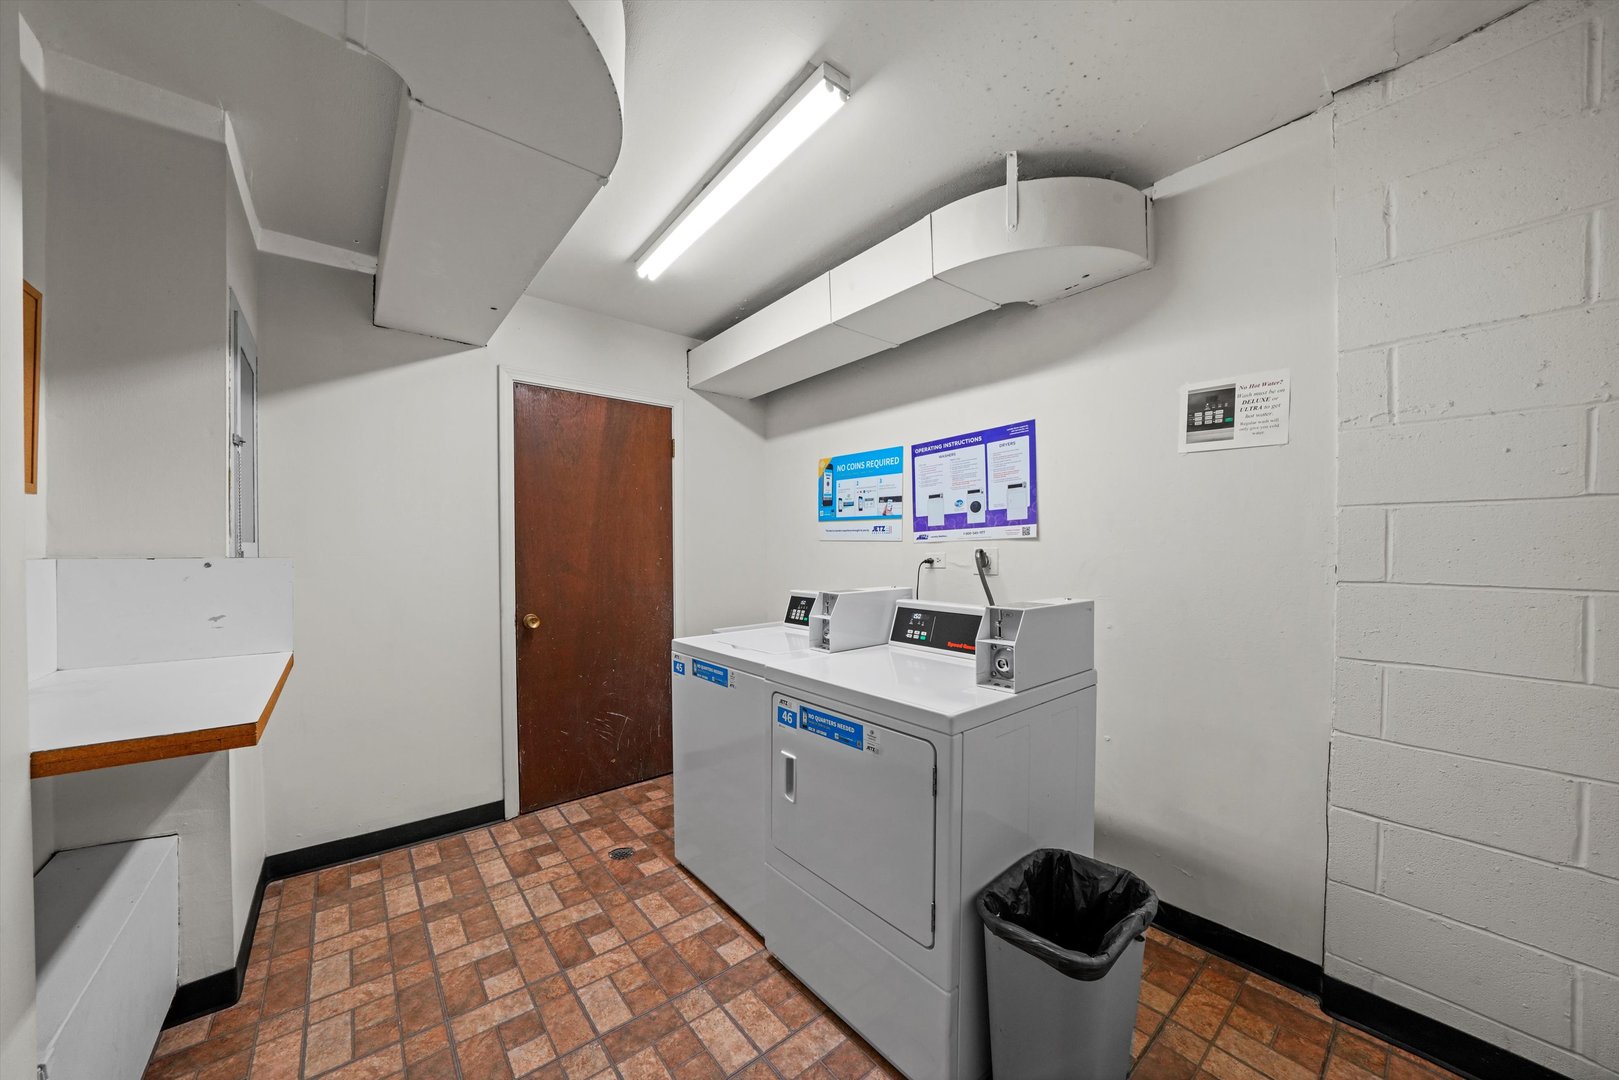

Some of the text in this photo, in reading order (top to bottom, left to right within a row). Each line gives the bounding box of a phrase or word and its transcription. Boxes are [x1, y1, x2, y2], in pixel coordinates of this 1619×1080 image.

[1262, 379, 1284, 387] Water?
[1242, 397, 1271, 405] DELUXE
[914, 436, 982, 454] OPERATING INSTRUCTIONS
[847, 461, 865, 471] COINS
[866, 456, 900, 468] REQUIRED
[676, 663, 682, 672] 45
[782, 711, 792, 724] 46
[815, 715, 837, 727] QUARTERS
[837, 723, 855, 733] NEEDED
